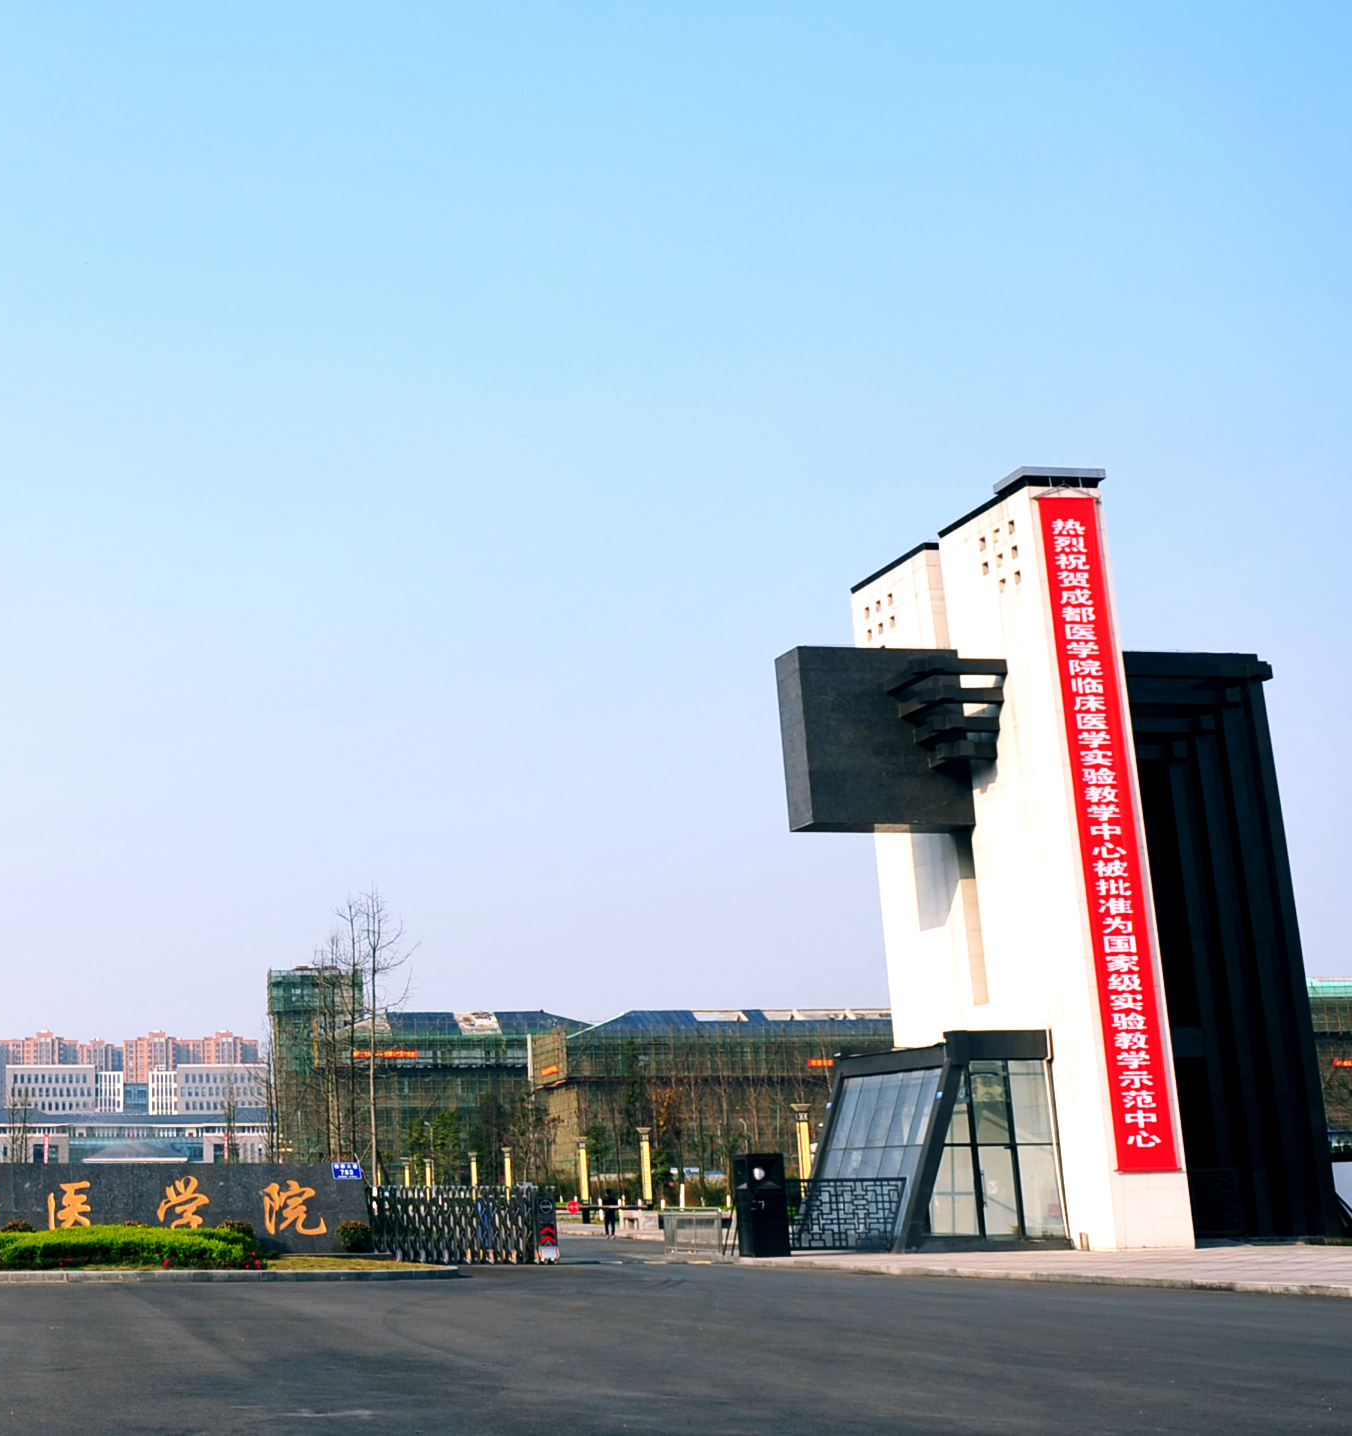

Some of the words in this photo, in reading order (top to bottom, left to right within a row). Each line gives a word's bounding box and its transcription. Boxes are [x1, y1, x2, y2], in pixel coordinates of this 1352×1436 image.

[1052, 518, 1161, 1147] 热烈祝贺成都医学院临床医学实验教学中心被批准为国家级实验教学示范中心
